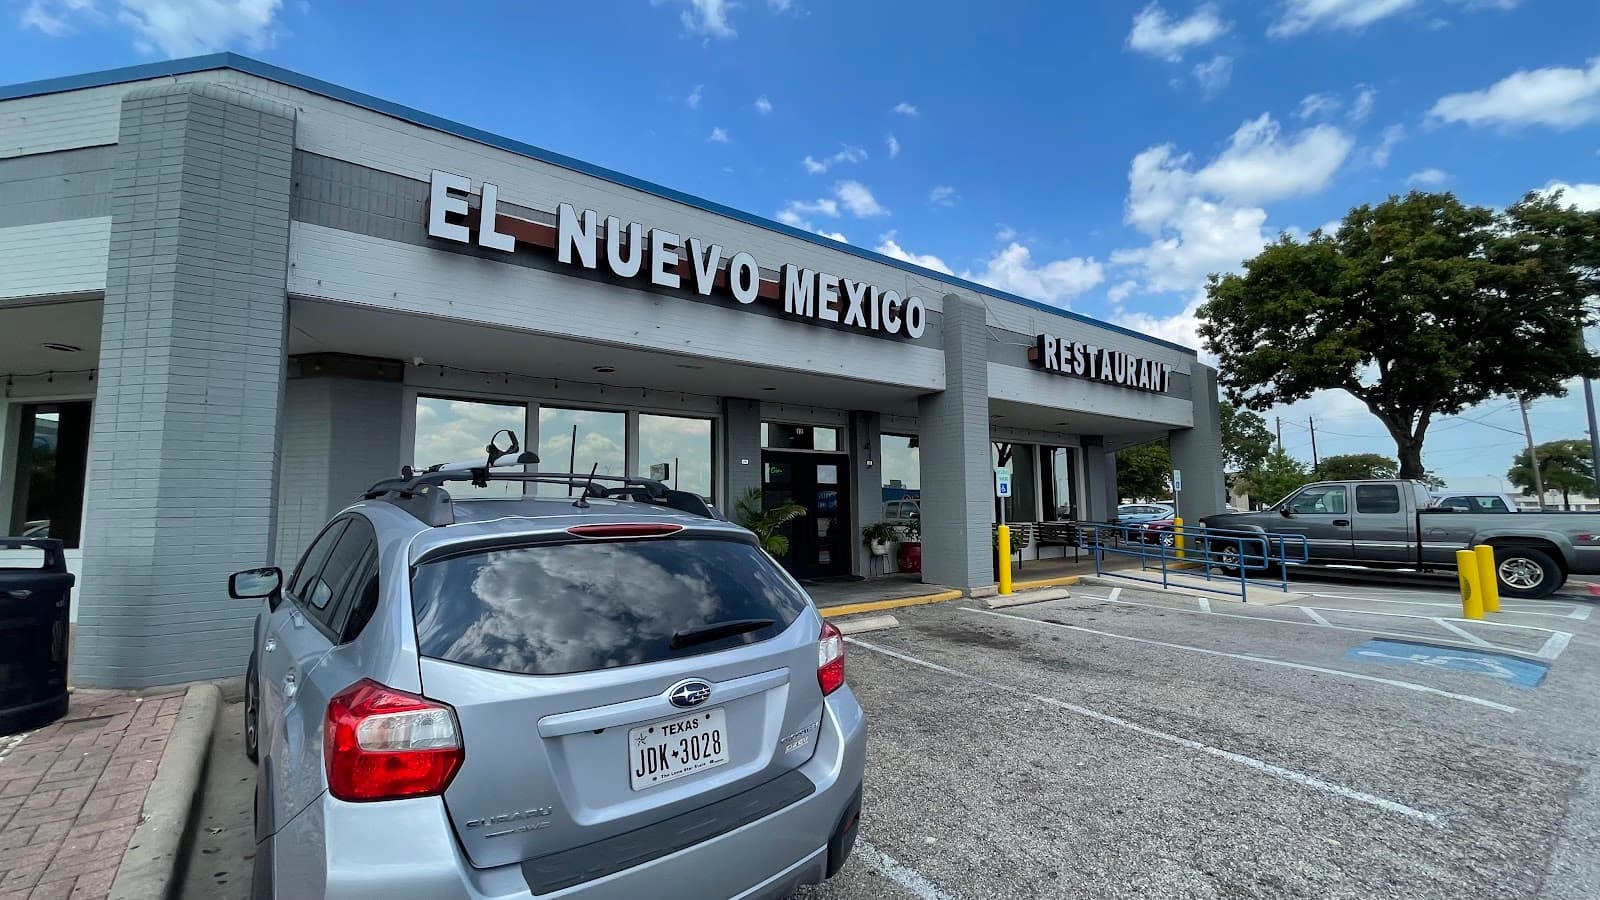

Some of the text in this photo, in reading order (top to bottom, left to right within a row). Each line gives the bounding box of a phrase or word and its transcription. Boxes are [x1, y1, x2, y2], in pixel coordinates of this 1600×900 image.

[428, 169, 1172, 393] EL NUEVO MEXICO RESTAURANT
[661, 718, 699, 737] TEXAS
